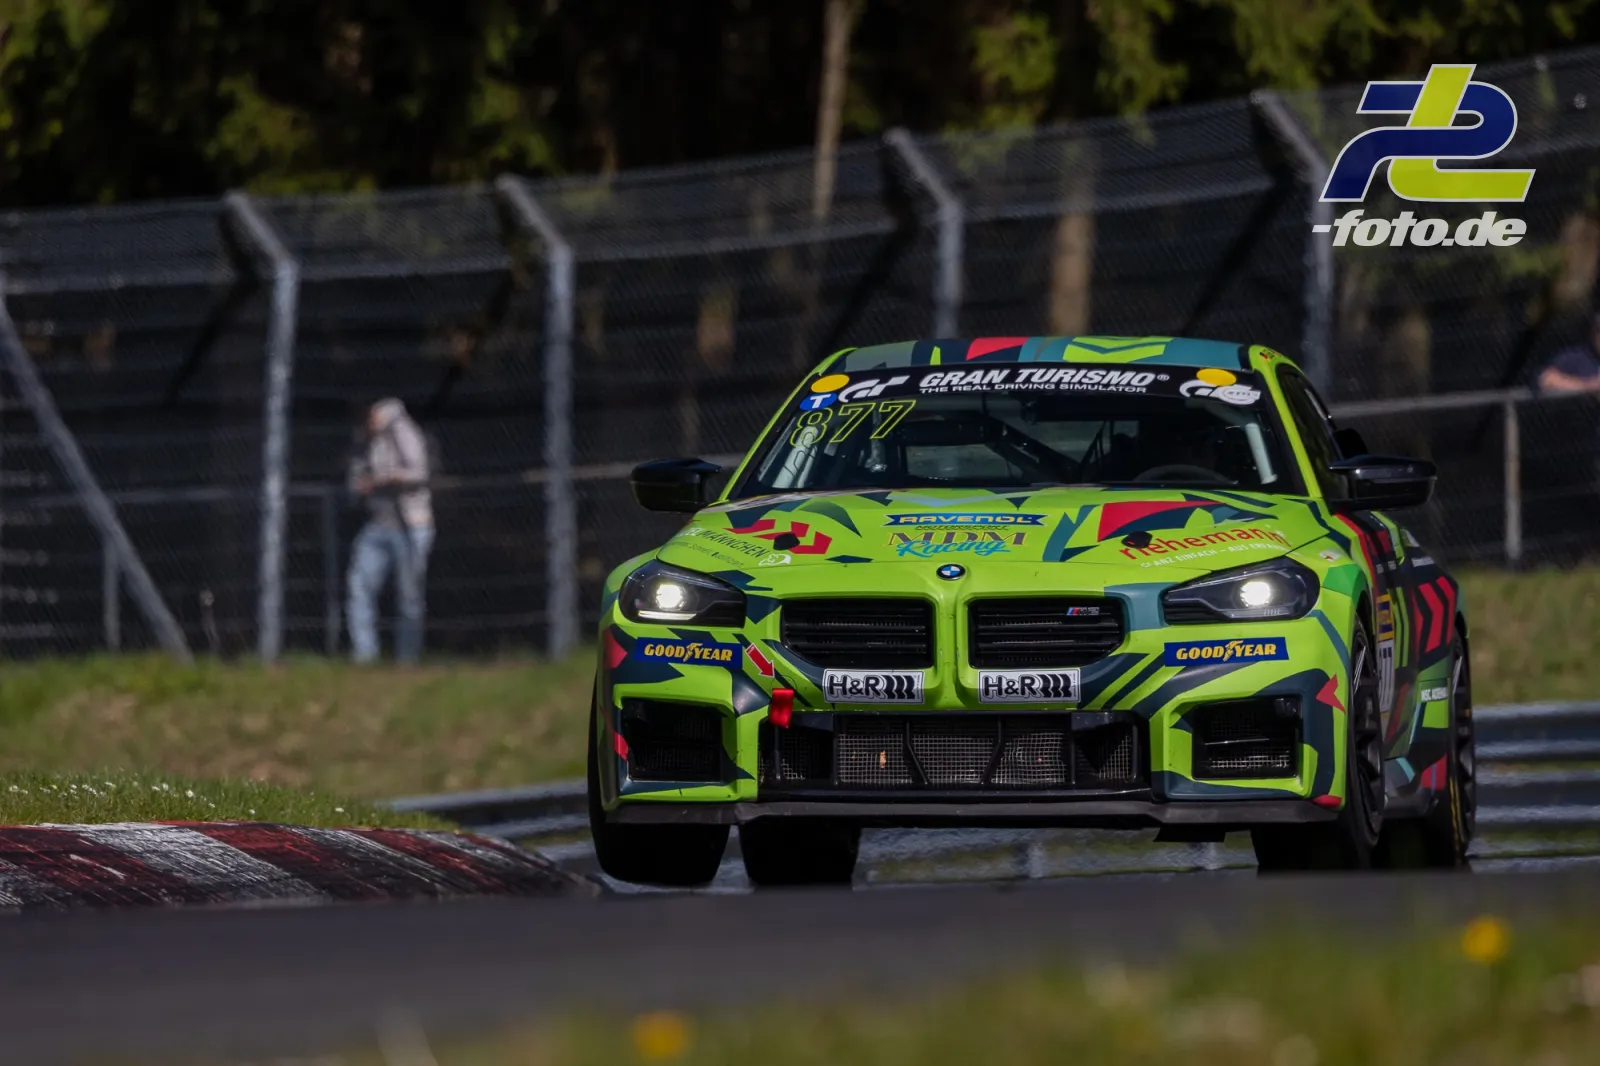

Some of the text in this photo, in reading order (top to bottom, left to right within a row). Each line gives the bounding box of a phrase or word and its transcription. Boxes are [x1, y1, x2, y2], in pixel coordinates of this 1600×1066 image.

[919, 369, 1011, 388] GRAN
[919, 386, 949, 394] THE
[952, 384, 991, 392] REAL
[1059, 383, 1147, 393] SIMULATOR
[810, 394, 832, 409] T
[789, 400, 917, 447] 877
[899, 515, 1033, 524] RAVENOL
[896, 540, 1011, 558] Racing
[644, 642, 733, 662] GOODYEAR
[1176, 640, 1277, 661] GOODYEAR
[828, 674, 887, 699] H&R
[982, 675, 1042, 699] H&R
